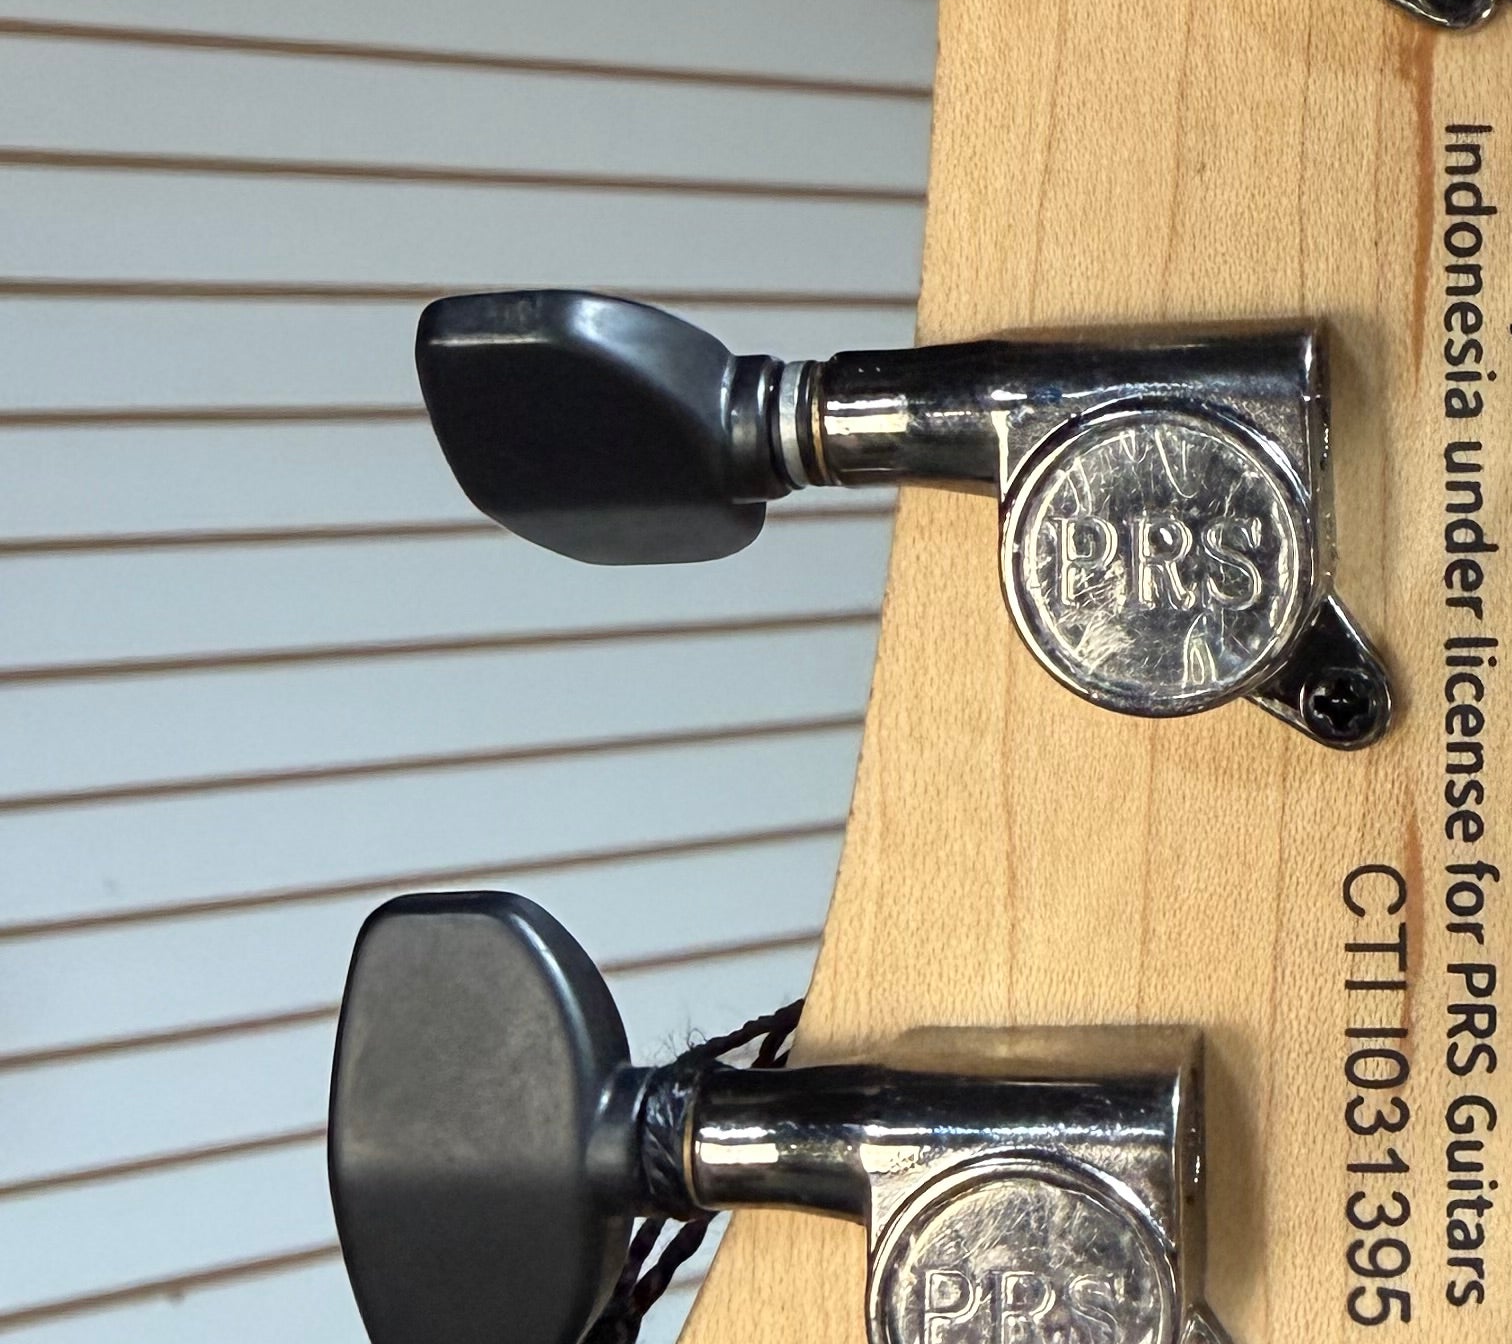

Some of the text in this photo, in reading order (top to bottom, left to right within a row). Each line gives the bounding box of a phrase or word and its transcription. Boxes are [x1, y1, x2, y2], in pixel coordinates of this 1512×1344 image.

[1044, 515, 1264, 611] PRS
[1444, 124, 1500, 1307] Indonesia under license for PRS Guitars
